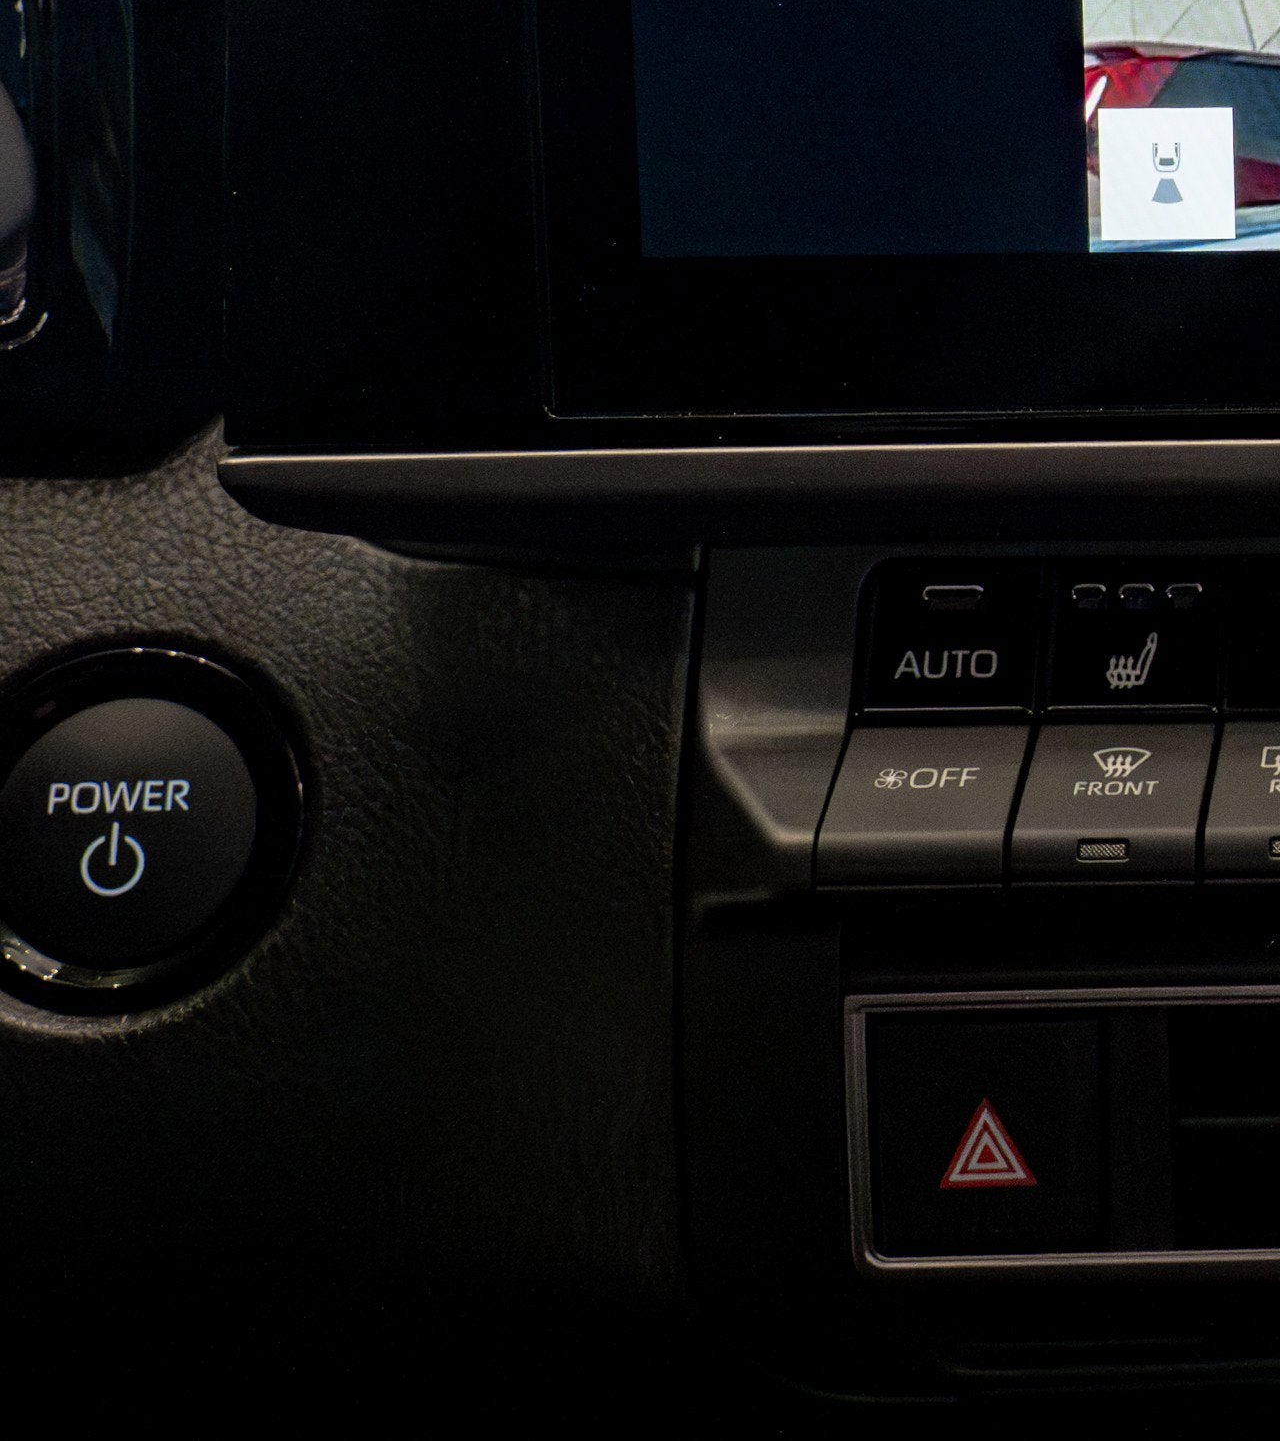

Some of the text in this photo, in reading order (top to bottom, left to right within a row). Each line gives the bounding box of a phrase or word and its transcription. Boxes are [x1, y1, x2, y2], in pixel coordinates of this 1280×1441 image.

[895, 649, 998, 680] AUTO
[910, 767, 979, 789] OFF
[1073, 780, 1159, 796] FRONT
[47, 779, 190, 815] POWER
